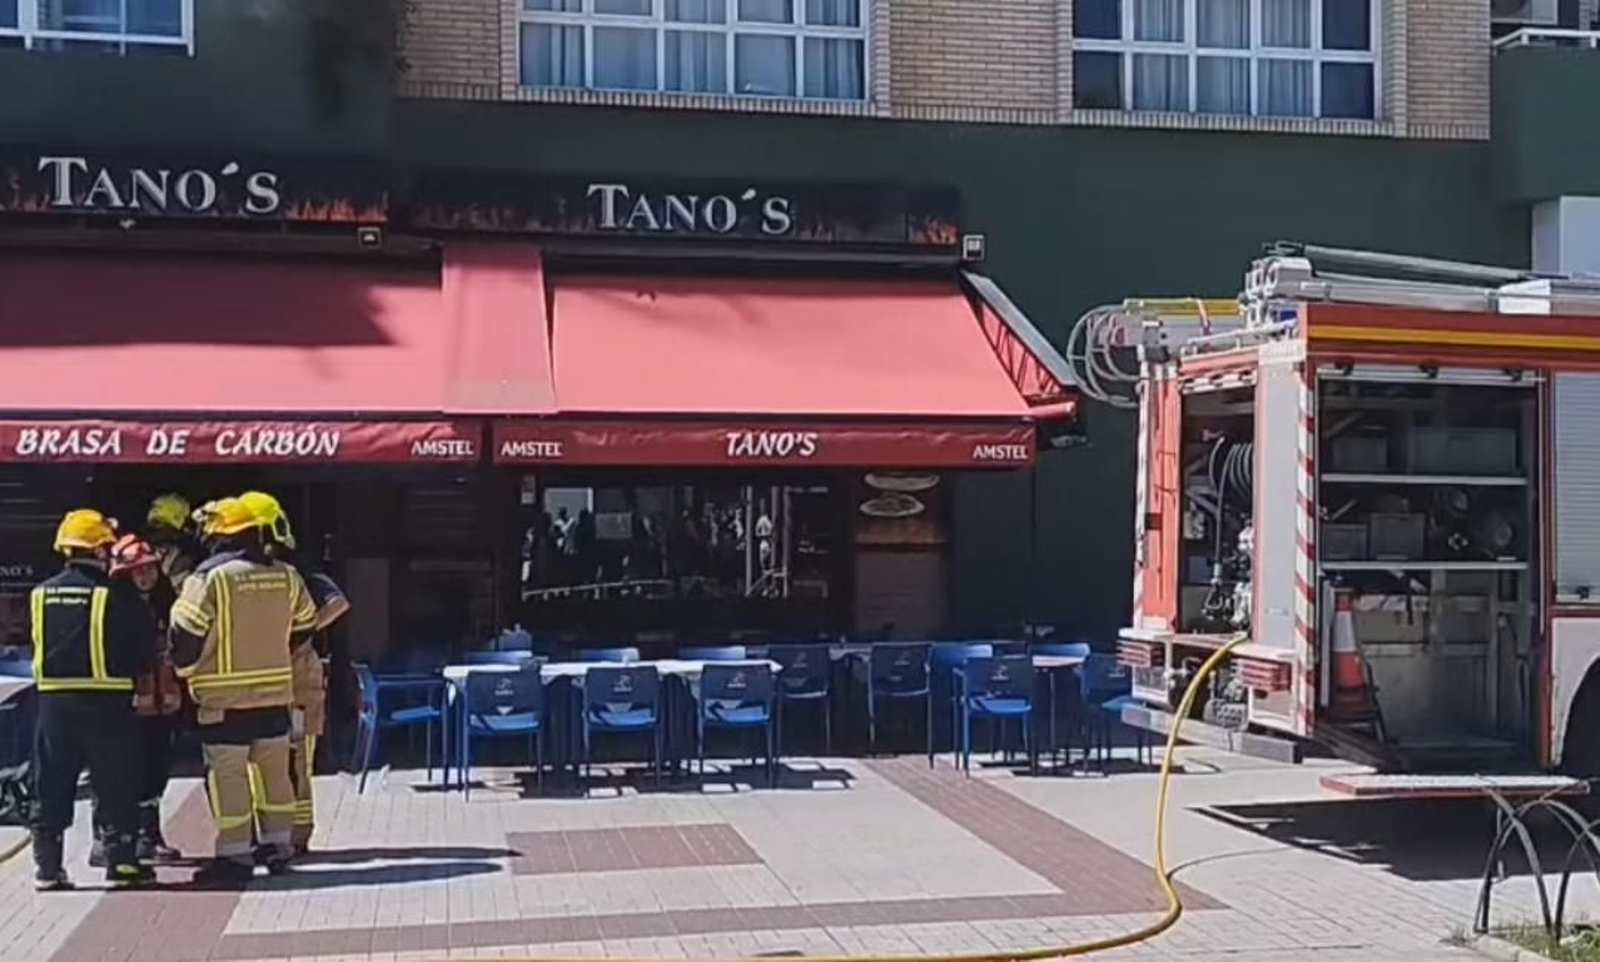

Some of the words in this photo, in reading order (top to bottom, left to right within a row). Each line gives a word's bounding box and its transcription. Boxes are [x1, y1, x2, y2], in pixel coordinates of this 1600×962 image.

[15, 428, 122, 456] BRASA
[146, 428, 190, 456] DE
[214, 425, 340, 457] CARBÓN
[411, 440, 474, 456] AMSTEL
[501, 441, 563, 457] AMSTEL
[726, 431, 818, 456] TANO'S
[973, 444, 1029, 459] AMSTEL
